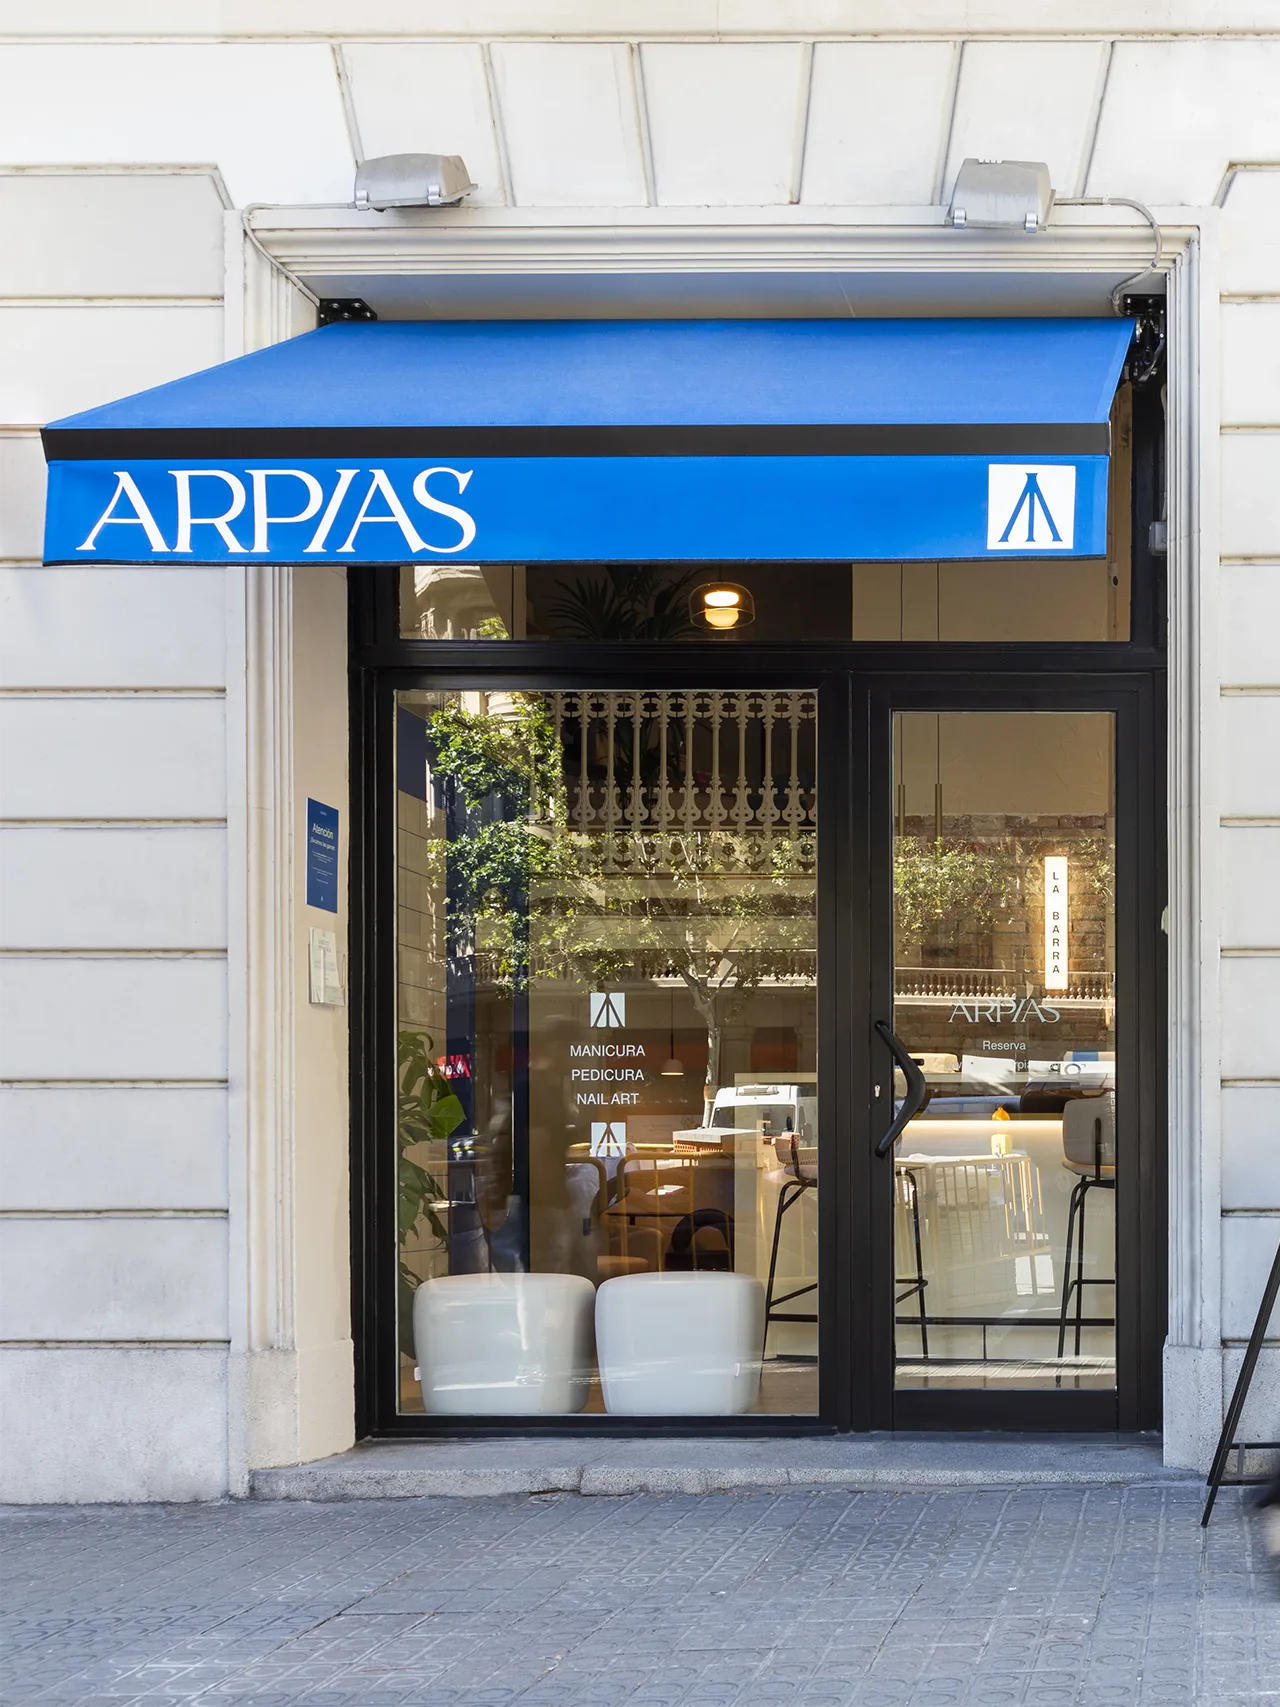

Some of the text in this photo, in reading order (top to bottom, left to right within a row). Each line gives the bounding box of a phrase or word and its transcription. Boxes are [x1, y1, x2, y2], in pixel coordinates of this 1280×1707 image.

[76, 466, 477, 554] ARPIAS
[312, 822, 334, 840] Atención
[1052, 871, 1060, 974] LA BARRA
[948, 998, 1061, 1023] ARPIAS
[570, 1044, 646, 1057] MANICURA
[982, 1040, 1026, 1051] Reserva
[571, 1069, 645, 1081] PEDICURA
[576, 1092, 640, 1105] NAIL ART
